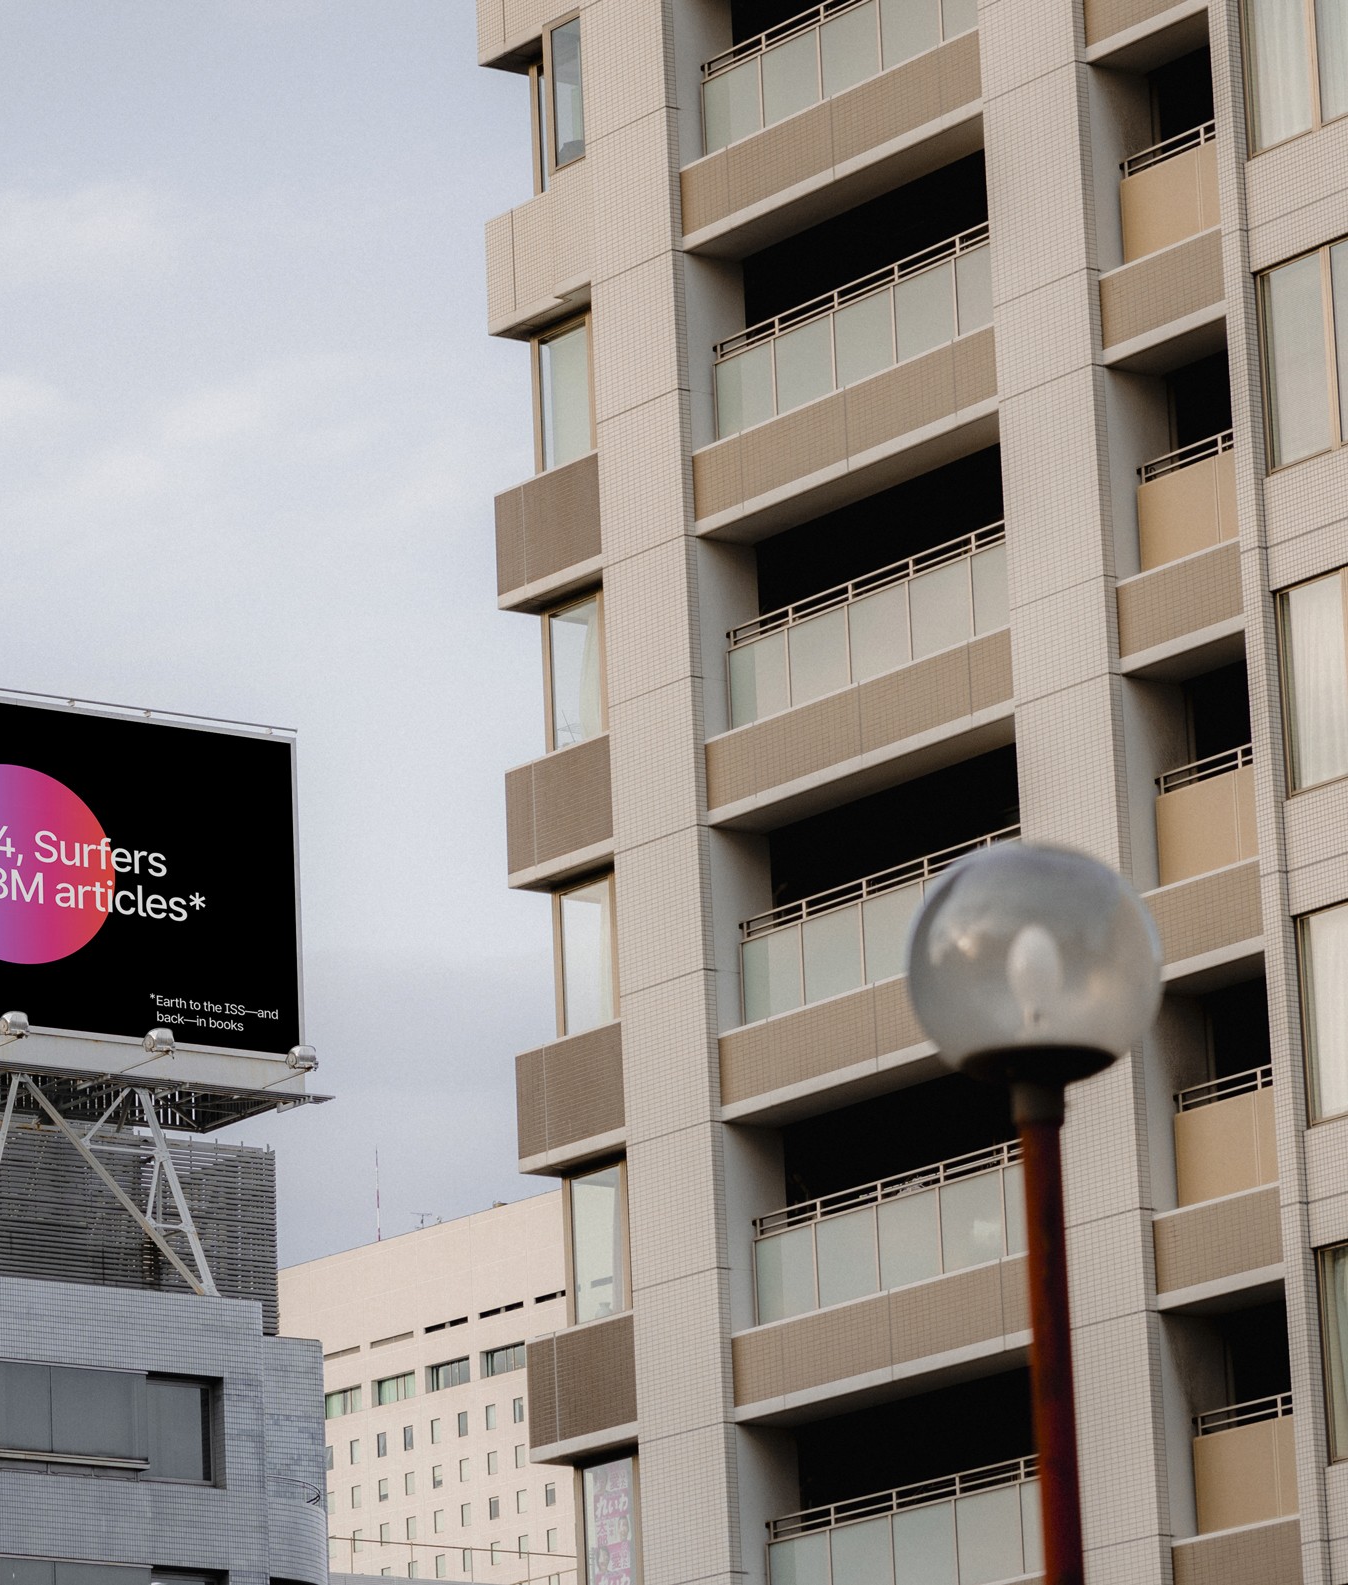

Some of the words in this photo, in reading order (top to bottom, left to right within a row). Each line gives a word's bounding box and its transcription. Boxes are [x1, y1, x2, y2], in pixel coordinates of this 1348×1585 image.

[34, 830, 168, 878] Surfers
[189, 1000, 201, 1011] to
[203, 1001, 222, 1013] the
[209, 1017, 244, 1031] books
[595, 1494, 629, 1519] れいわ
